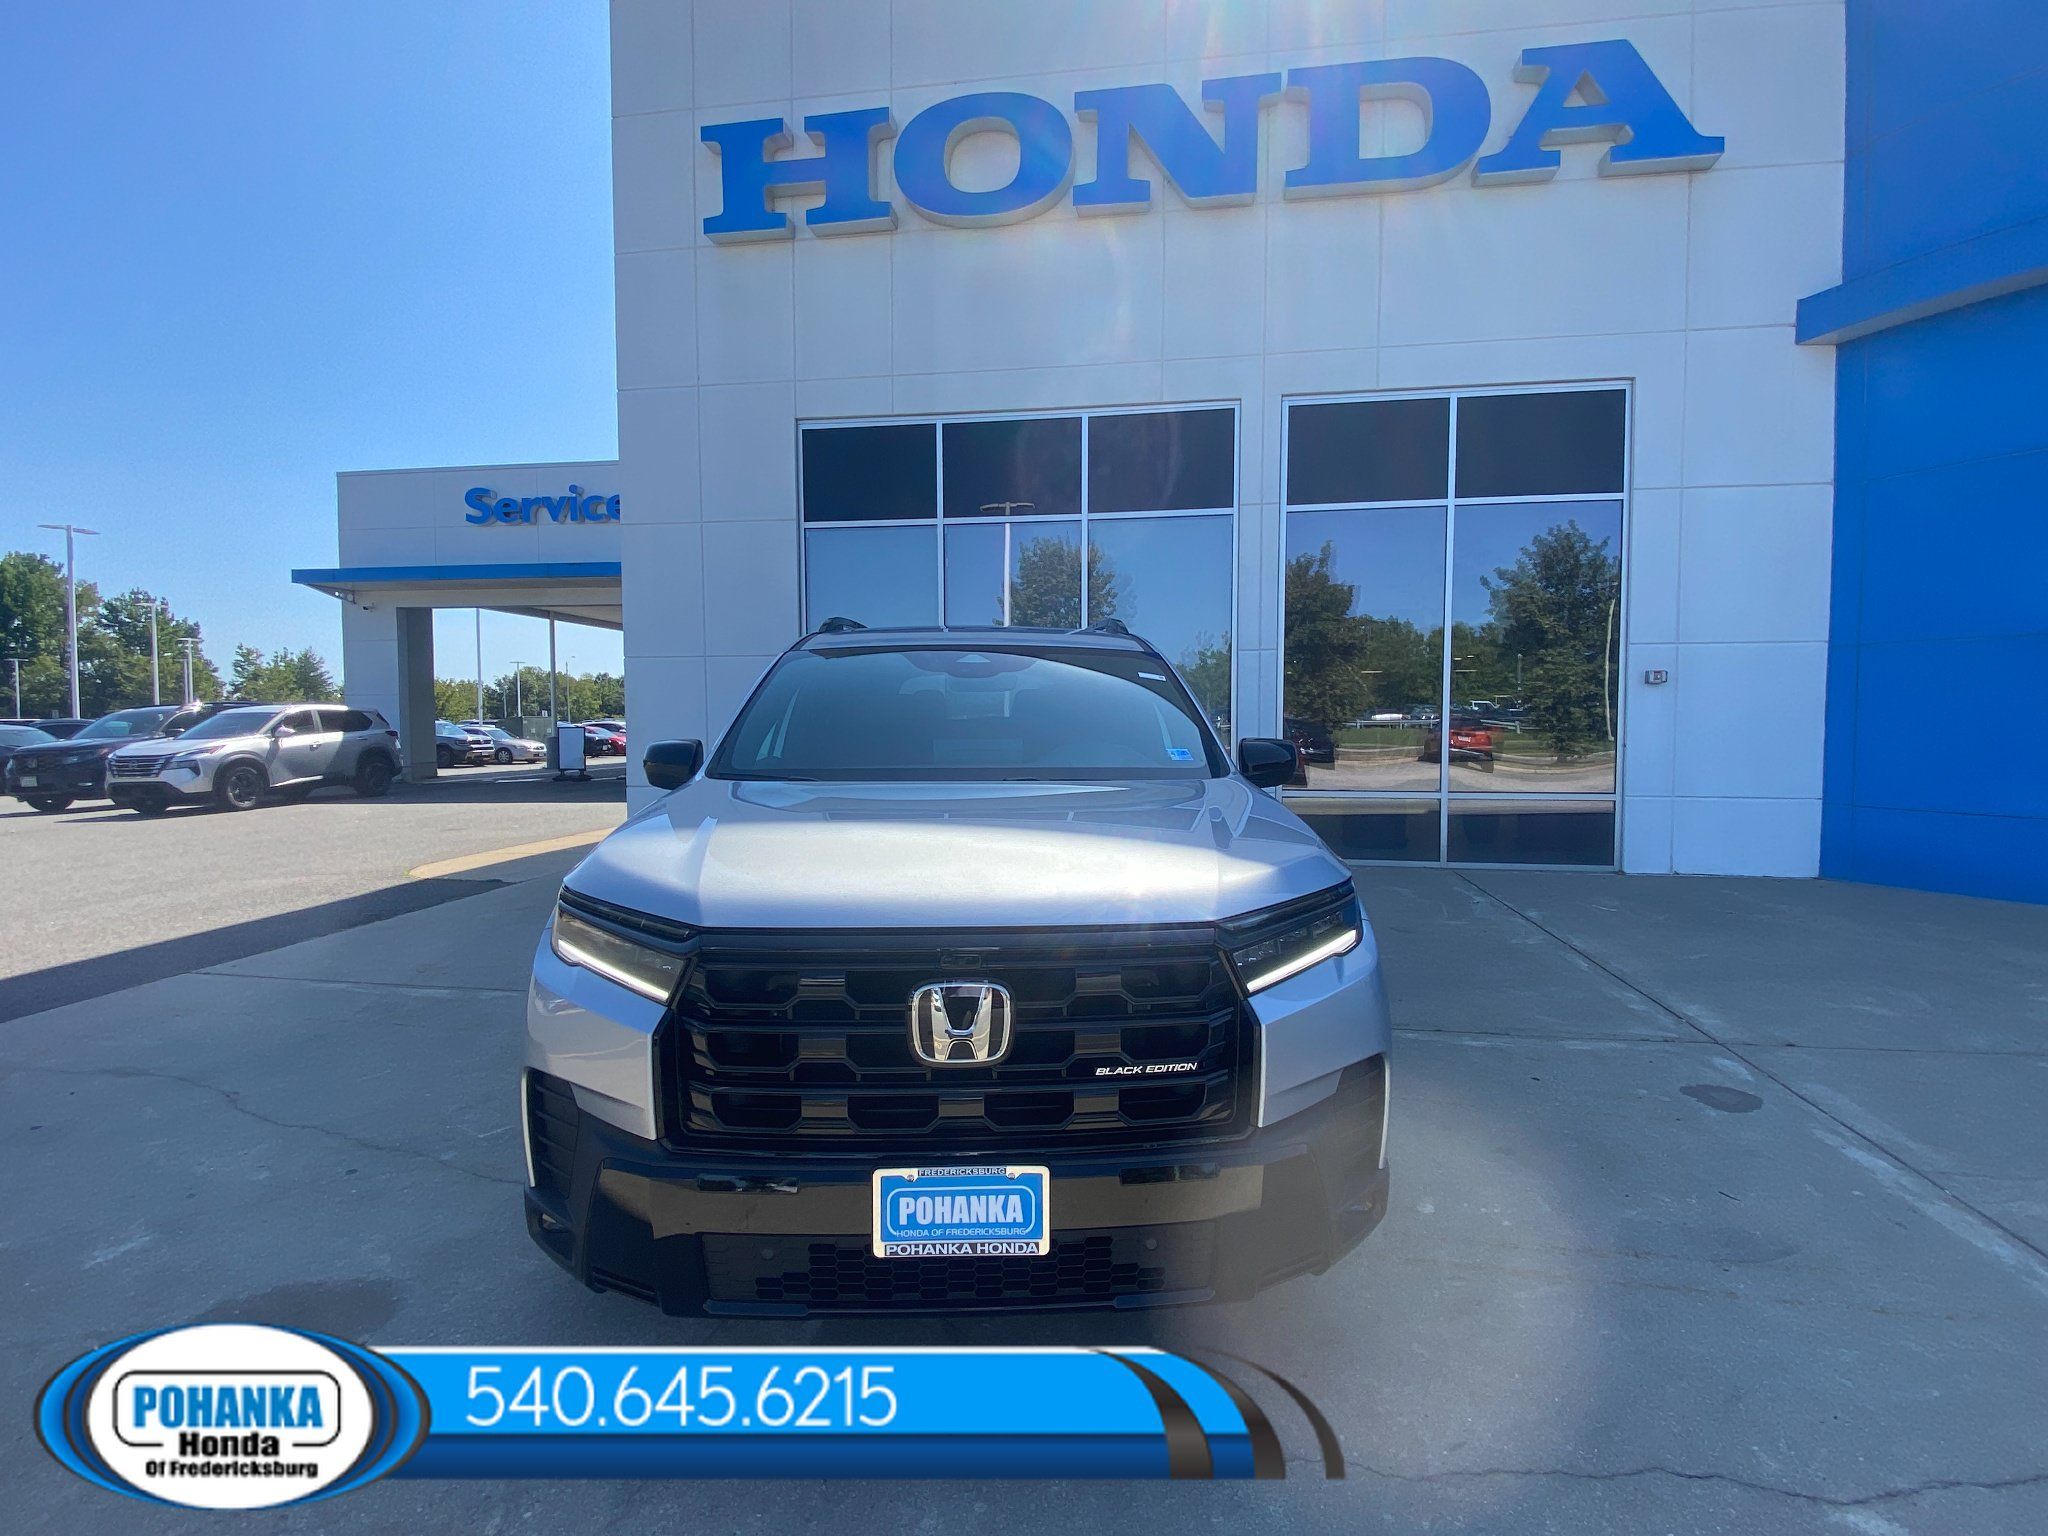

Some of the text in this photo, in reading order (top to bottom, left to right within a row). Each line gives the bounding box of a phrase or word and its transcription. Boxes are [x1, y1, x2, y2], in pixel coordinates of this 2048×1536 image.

[700, 39, 1725, 245] HONDA
[1095, 1062, 1198, 1076] BLACK EDITION
[918, 1168, 1006, 1176] FREDERICKSBURG
[900, 1195, 1023, 1226] POHANKA
[896, 1228, 1026, 1238] HONDA OF FREDERICKSBURG
[886, 1242, 1039, 1256] POHANKA HONDA
